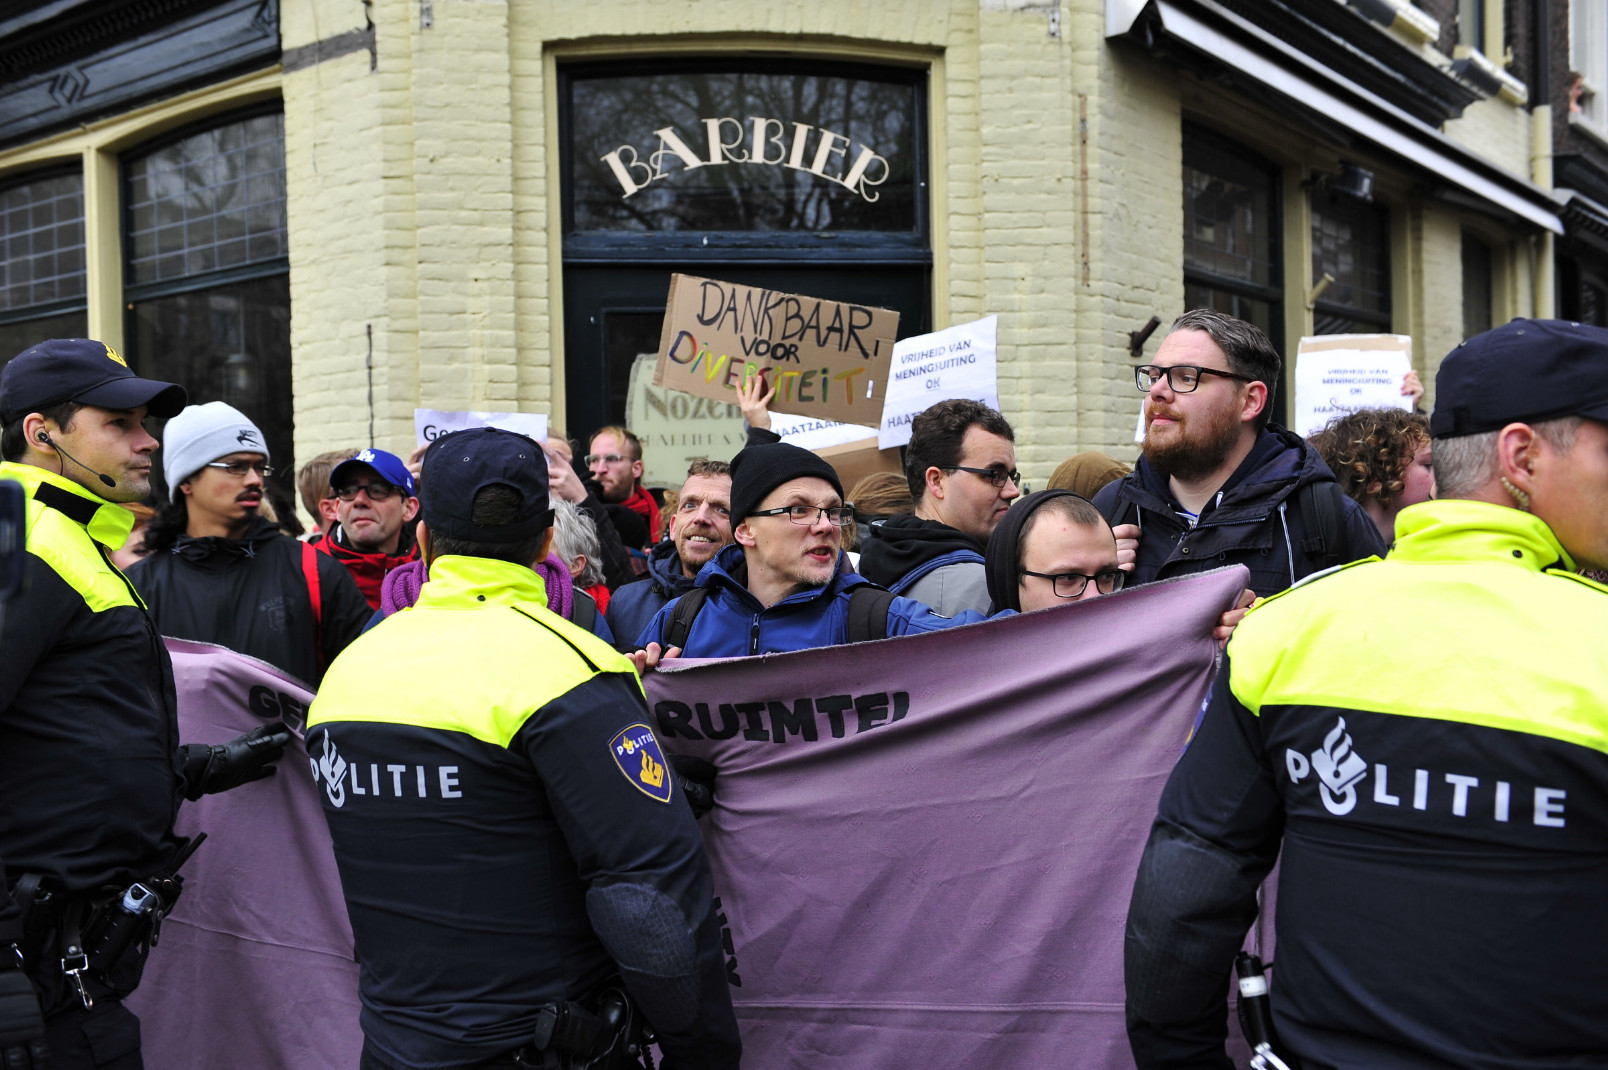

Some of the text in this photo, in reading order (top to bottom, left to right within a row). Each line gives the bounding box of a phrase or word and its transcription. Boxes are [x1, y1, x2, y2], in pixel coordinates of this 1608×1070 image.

[600, 116, 890, 203] BARBIER
[741, 336, 801, 363] VOOR
[901, 339, 972, 365] VRIJHEID VAN
[895, 353, 976, 381] MENINGSUITING
[925, 377, 941, 391] OK
[616, 733, 654, 756] POLITIE
[1286, 745, 1567, 828] POLITIE
